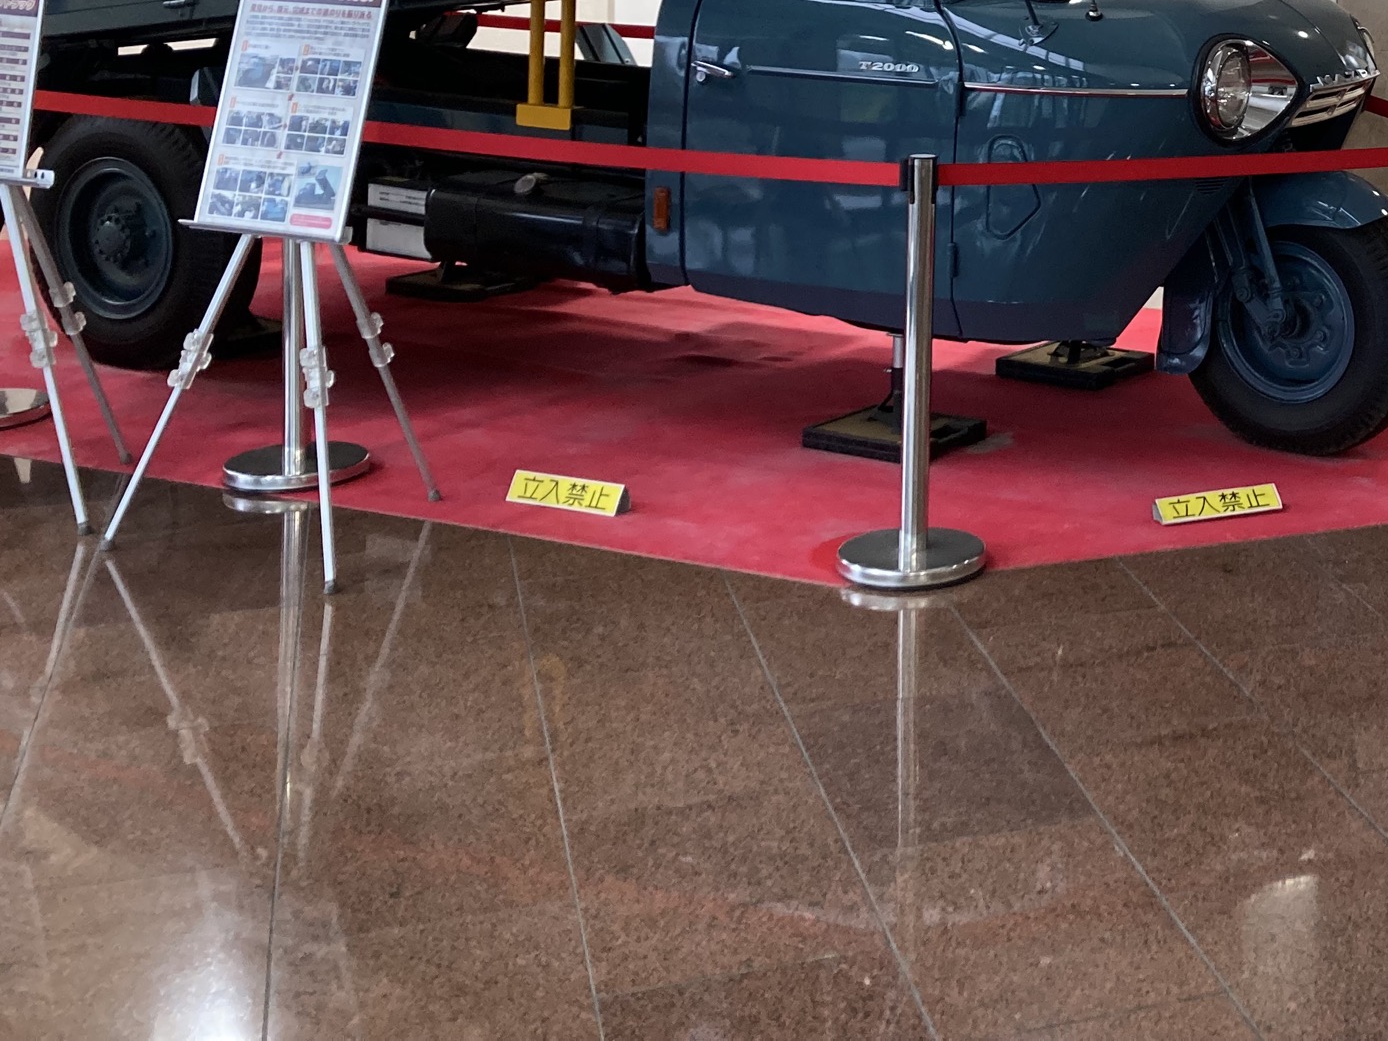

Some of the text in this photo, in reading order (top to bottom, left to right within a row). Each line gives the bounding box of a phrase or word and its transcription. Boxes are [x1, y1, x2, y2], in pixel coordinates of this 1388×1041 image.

[859, 61, 919, 73] T2000
[517, 476, 610, 510] 立入禁止
[1168, 489, 1270, 519] 立入禁止
